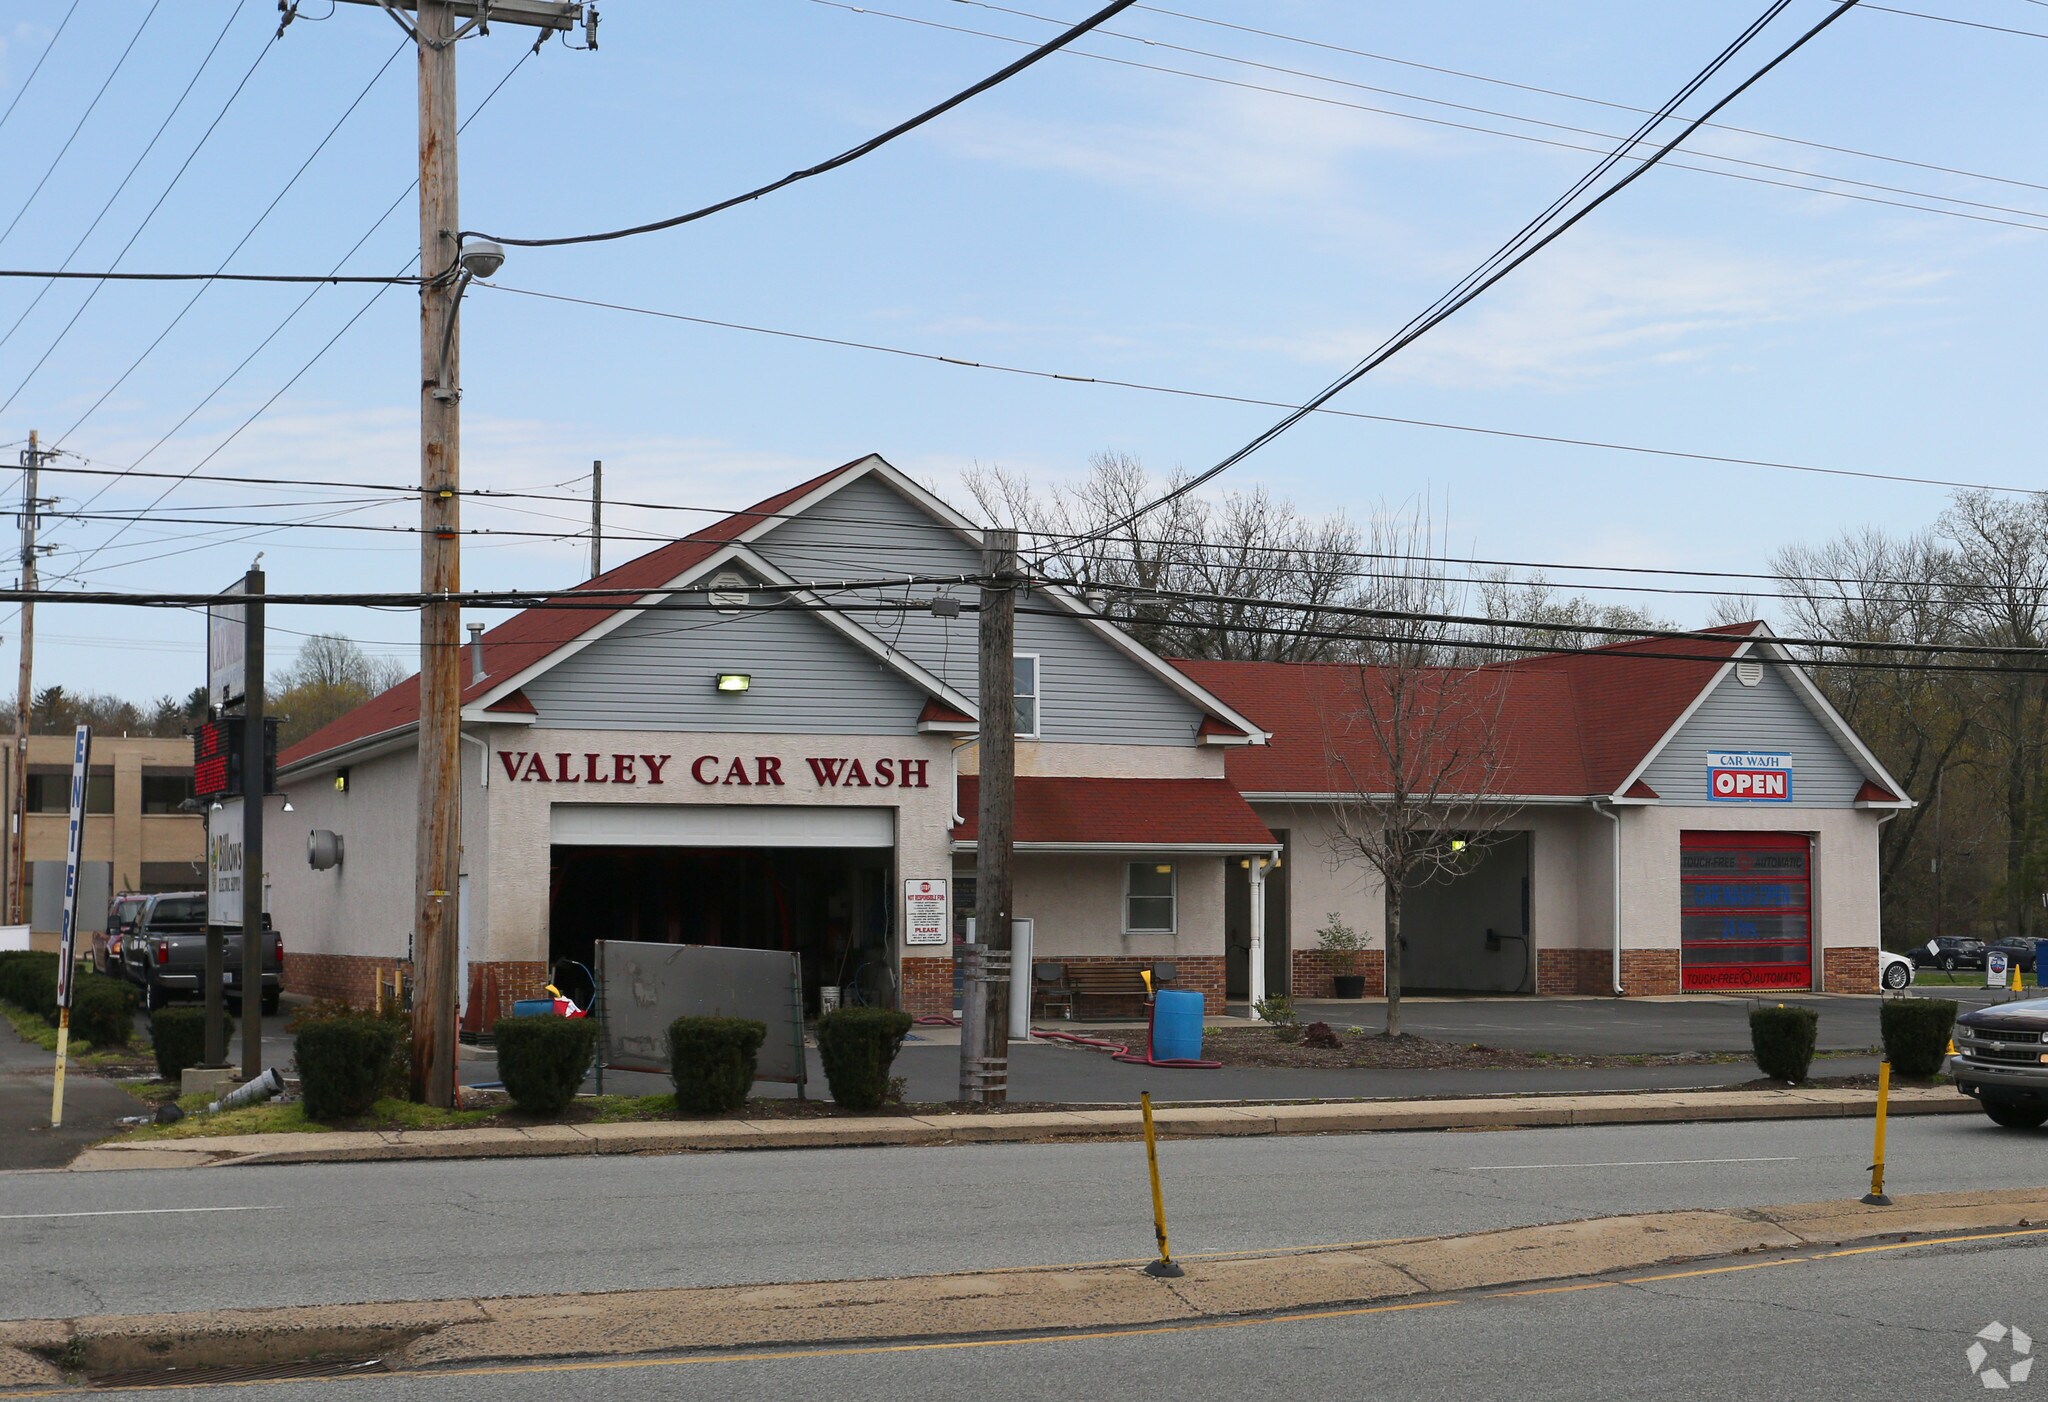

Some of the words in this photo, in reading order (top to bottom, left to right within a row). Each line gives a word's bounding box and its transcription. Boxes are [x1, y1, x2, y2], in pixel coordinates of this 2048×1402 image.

[497, 751, 671, 785] VALLEY
[691, 755, 785, 786] CAR
[806, 757, 929, 788] WASH
[1720, 755, 1743, 766] CAR
[1746, 756, 1779, 767] WASH
[1716, 773, 1784, 795] OPEN
[62, 731, 84, 942] ENTER
[218, 832, 242, 872] Billows
[1682, 856, 1735, 868] TOUCH-FREE
[1754, 856, 1802, 868] AUTOMATIC
[1695, 884, 1720, 906] CAR
[1759, 884, 1792, 906] OPEN
[1687, 973, 1740, 985] TOUCH-FREE
[1753, 971, 1802, 983] AUTOMATIC
